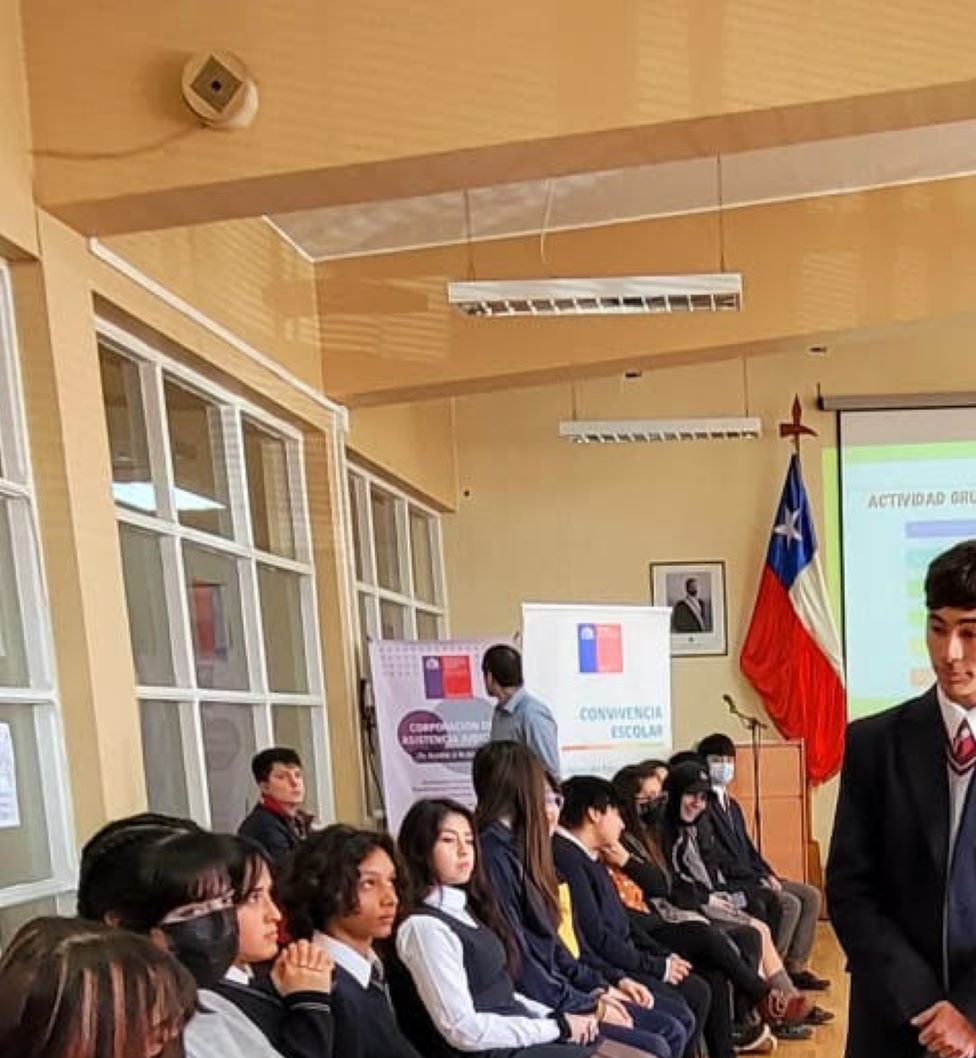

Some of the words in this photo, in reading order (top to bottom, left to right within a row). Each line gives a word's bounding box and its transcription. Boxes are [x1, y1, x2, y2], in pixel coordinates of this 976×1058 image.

[868, 491, 946, 509] ACTIVIDAD
[579, 705, 663, 721] CONVIVENCIA
[611, 724, 663, 739] ESCOLAR
